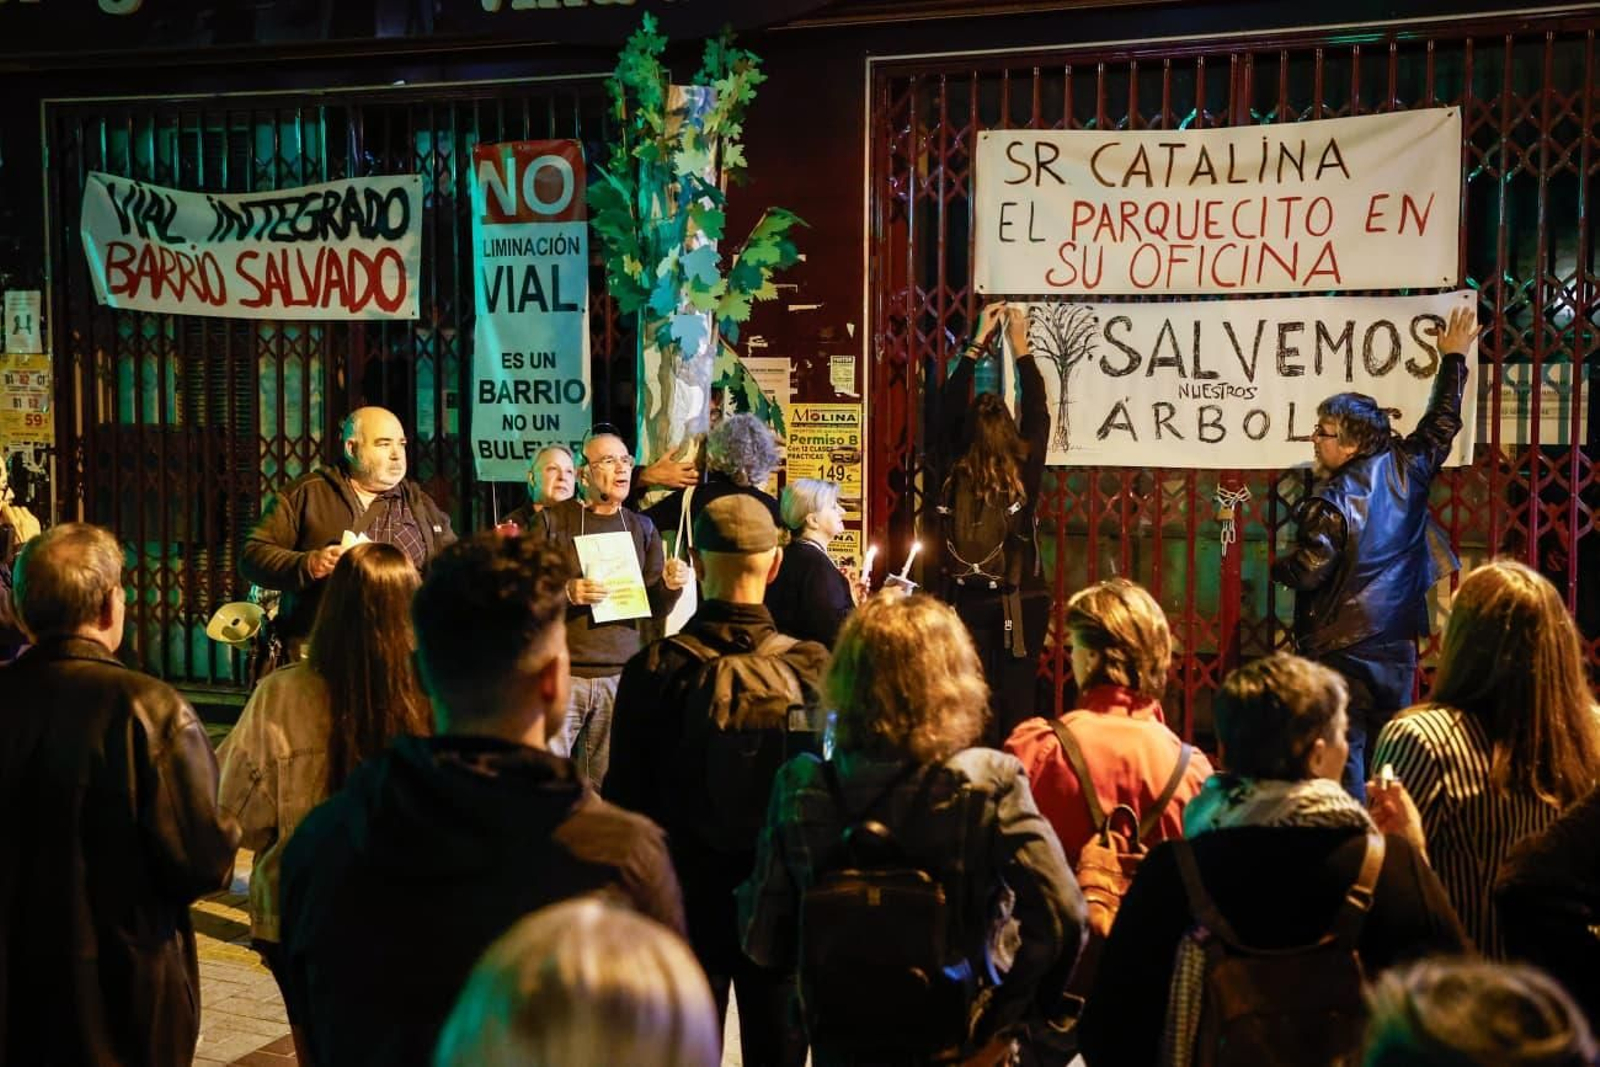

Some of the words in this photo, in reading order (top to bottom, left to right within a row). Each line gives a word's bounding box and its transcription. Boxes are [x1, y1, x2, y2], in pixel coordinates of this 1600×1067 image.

[1004, 141, 1066, 187] SR
[1090, 136, 1350, 187] CATALINA
[478, 154, 575, 216] NO
[107, 180, 186, 243] VIAL
[206, 185, 410, 243] INTEGRADO
[999, 200, 1046, 243] EL
[1071, 197, 1334, 242] PARQUECITO
[1365, 192, 1435, 236] EN
[482, 231, 580, 257] LIMINACIÓN
[105, 241, 226, 306] BARRIO
[235, 246, 407, 313] SALVADO
[1045, 241, 1104, 289] SU
[1129, 240, 1342, 289] OFICINA
[501, 352, 524, 370] ES
[530, 352, 556, 370] UN
[1099, 313, 1446, 382] SALVEMOS
[478, 379, 586, 404] BARRIO
[1178, 381, 1259, 400] NUESTROS
[502, 414, 527, 431] NO
[532, 414, 560, 431] UN
[792, 408, 856, 422] MOLINA
[790, 434, 845, 446] Permiso
[848, 435, 858, 446] B
